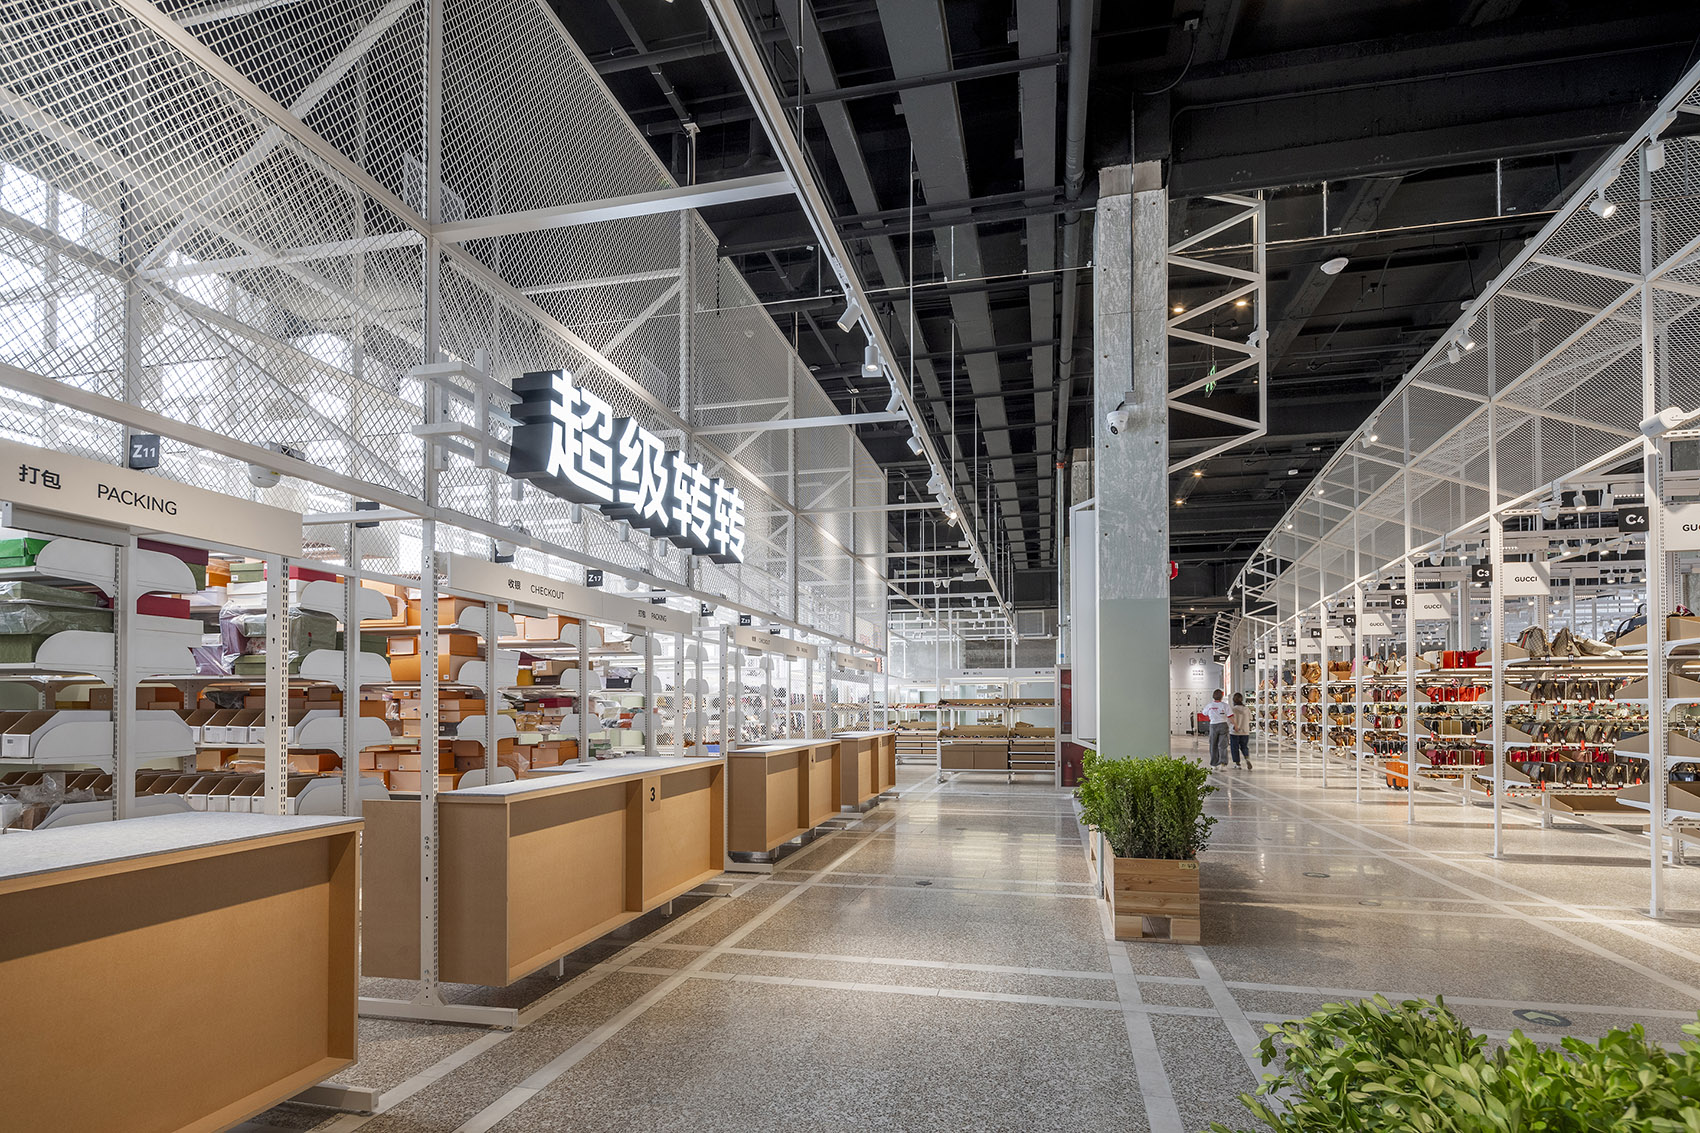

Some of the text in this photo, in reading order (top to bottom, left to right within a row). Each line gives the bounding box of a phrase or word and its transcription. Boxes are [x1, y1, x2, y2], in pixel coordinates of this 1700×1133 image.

[132, 444, 156, 459] Z11
[547, 369, 745, 563] 超级转转
[19, 464, 178, 516] 打包 PACKING
[1625, 514, 1645, 525] C4
[1682, 524, 1700, 532] GU
[1477, 568, 1490, 577] C3
[507, 578, 565, 600] 收银 CHECKOUT
[650, 787, 656, 802] 3
